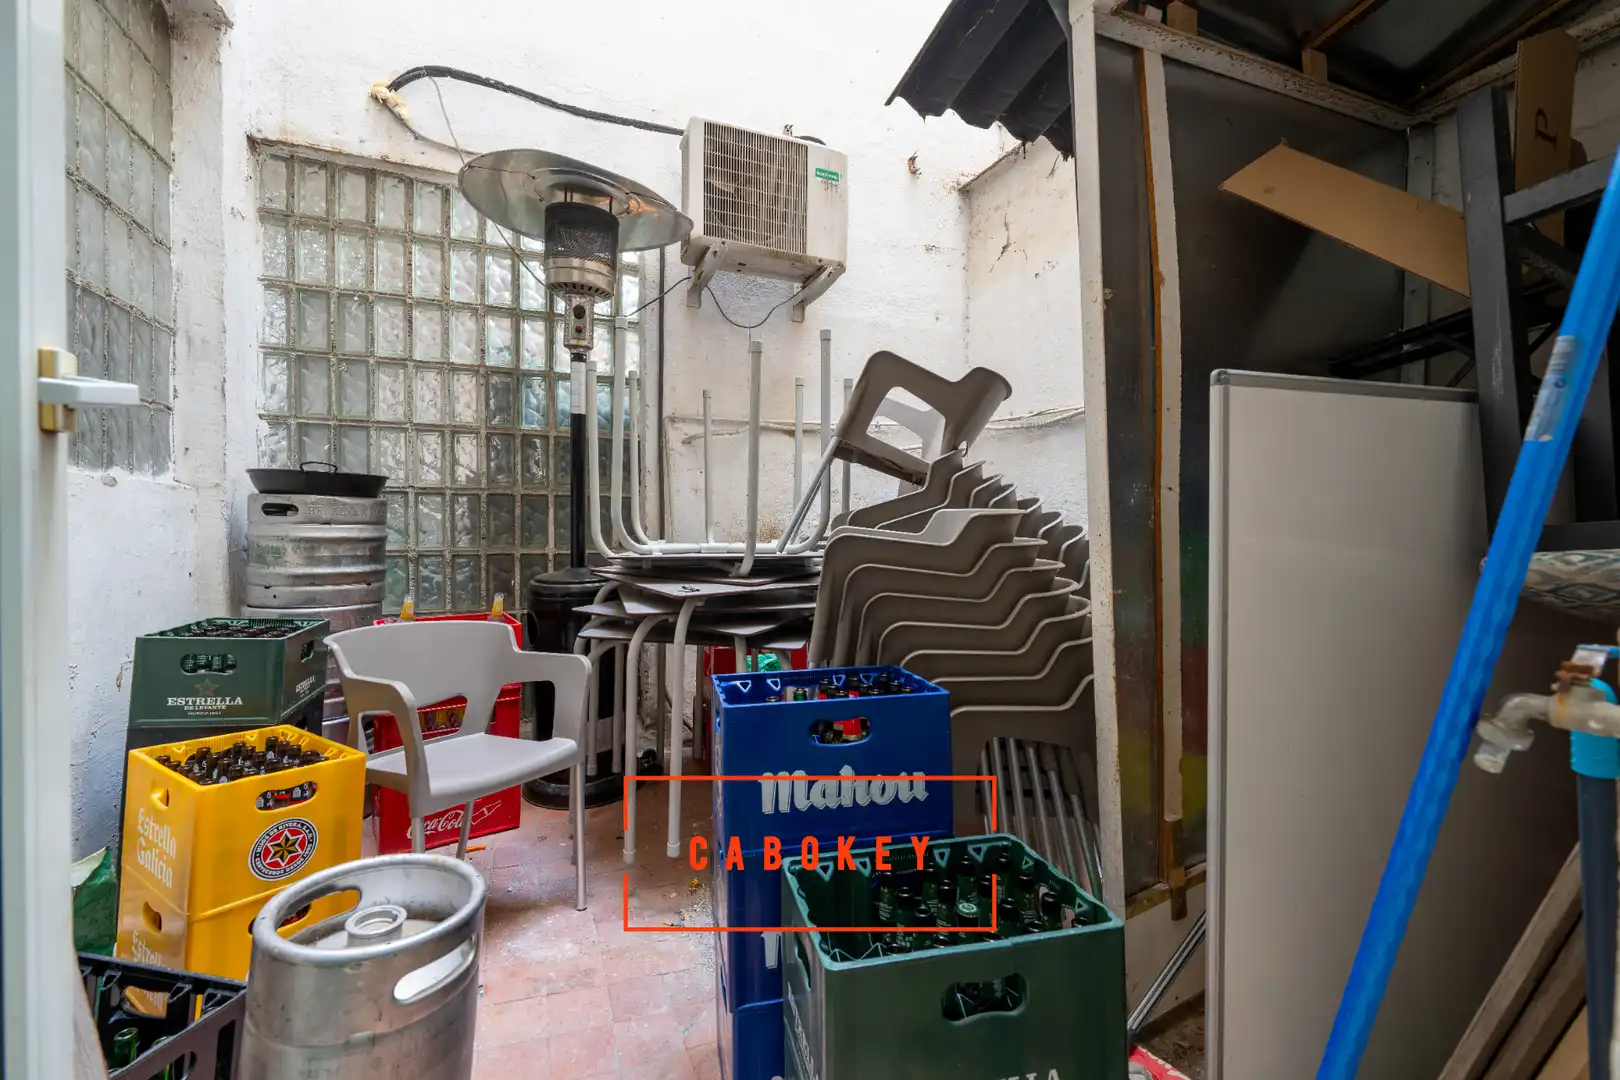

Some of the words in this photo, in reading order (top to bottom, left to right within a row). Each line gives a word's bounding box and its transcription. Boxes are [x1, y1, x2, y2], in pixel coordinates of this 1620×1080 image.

[166, 697, 244, 706] ESTRELLA
[758, 764, 929, 815] Mahou
[137, 807, 176, 860] Estrella
[136, 837, 173, 889] Galicia
[131, 930, 162, 967] Estrell
